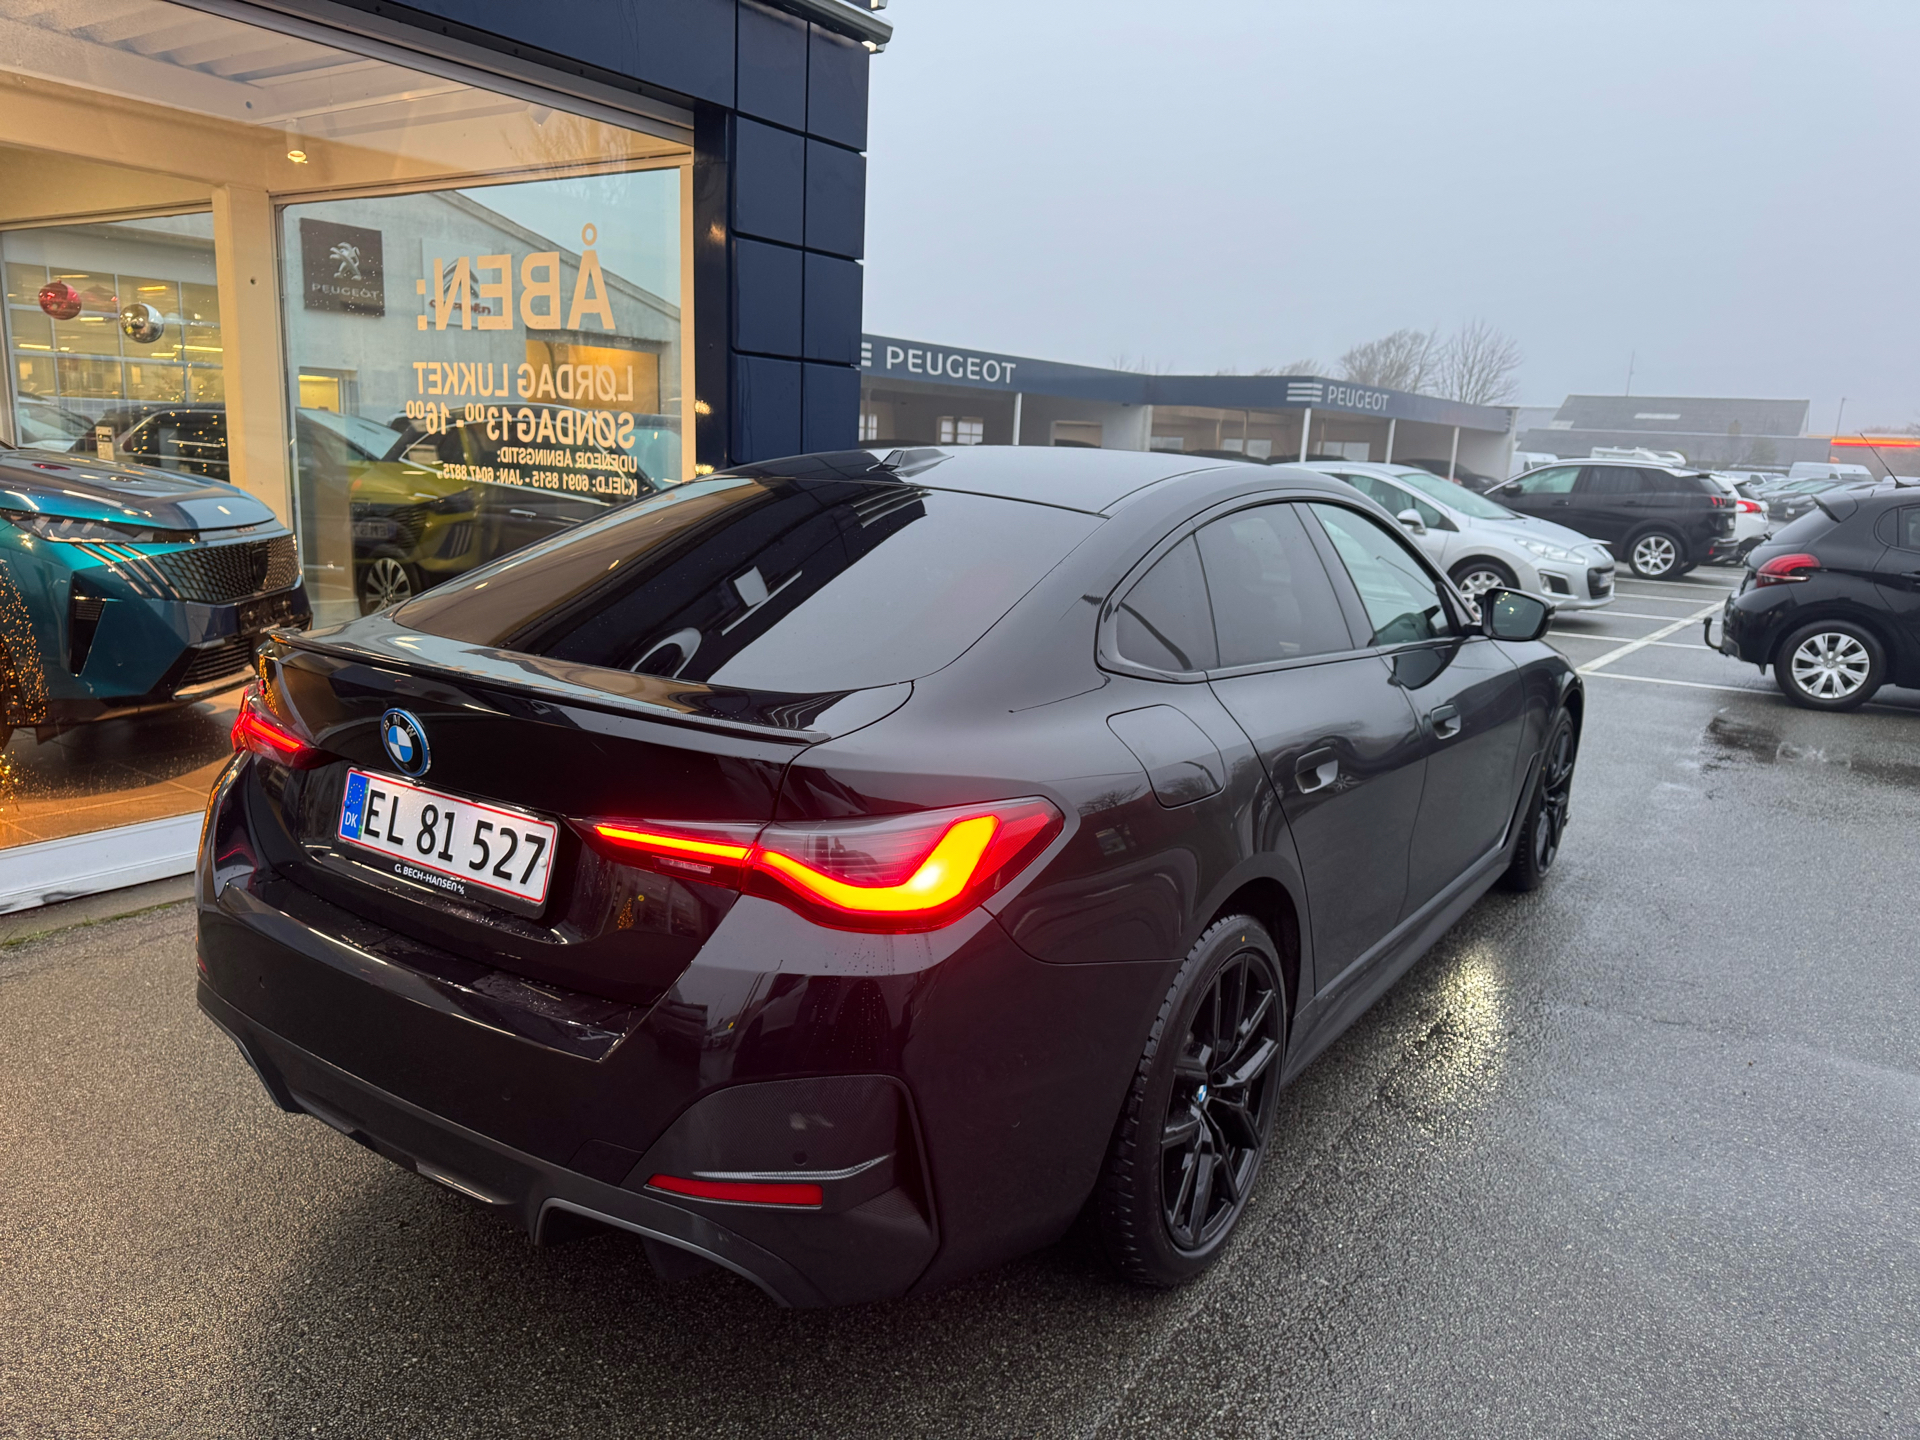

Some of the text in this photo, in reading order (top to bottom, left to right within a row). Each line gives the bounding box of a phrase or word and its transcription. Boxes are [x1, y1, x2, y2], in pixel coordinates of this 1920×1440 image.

[312, 282, 380, 300] PEUGEOT
[886, 345, 1016, 384] PEUGEOT
[1328, 385, 1389, 411] PEUGEOT
[383, 714, 416, 738] BMW
[344, 811, 357, 828] DK
[363, 789, 547, 885] EL 81 527
